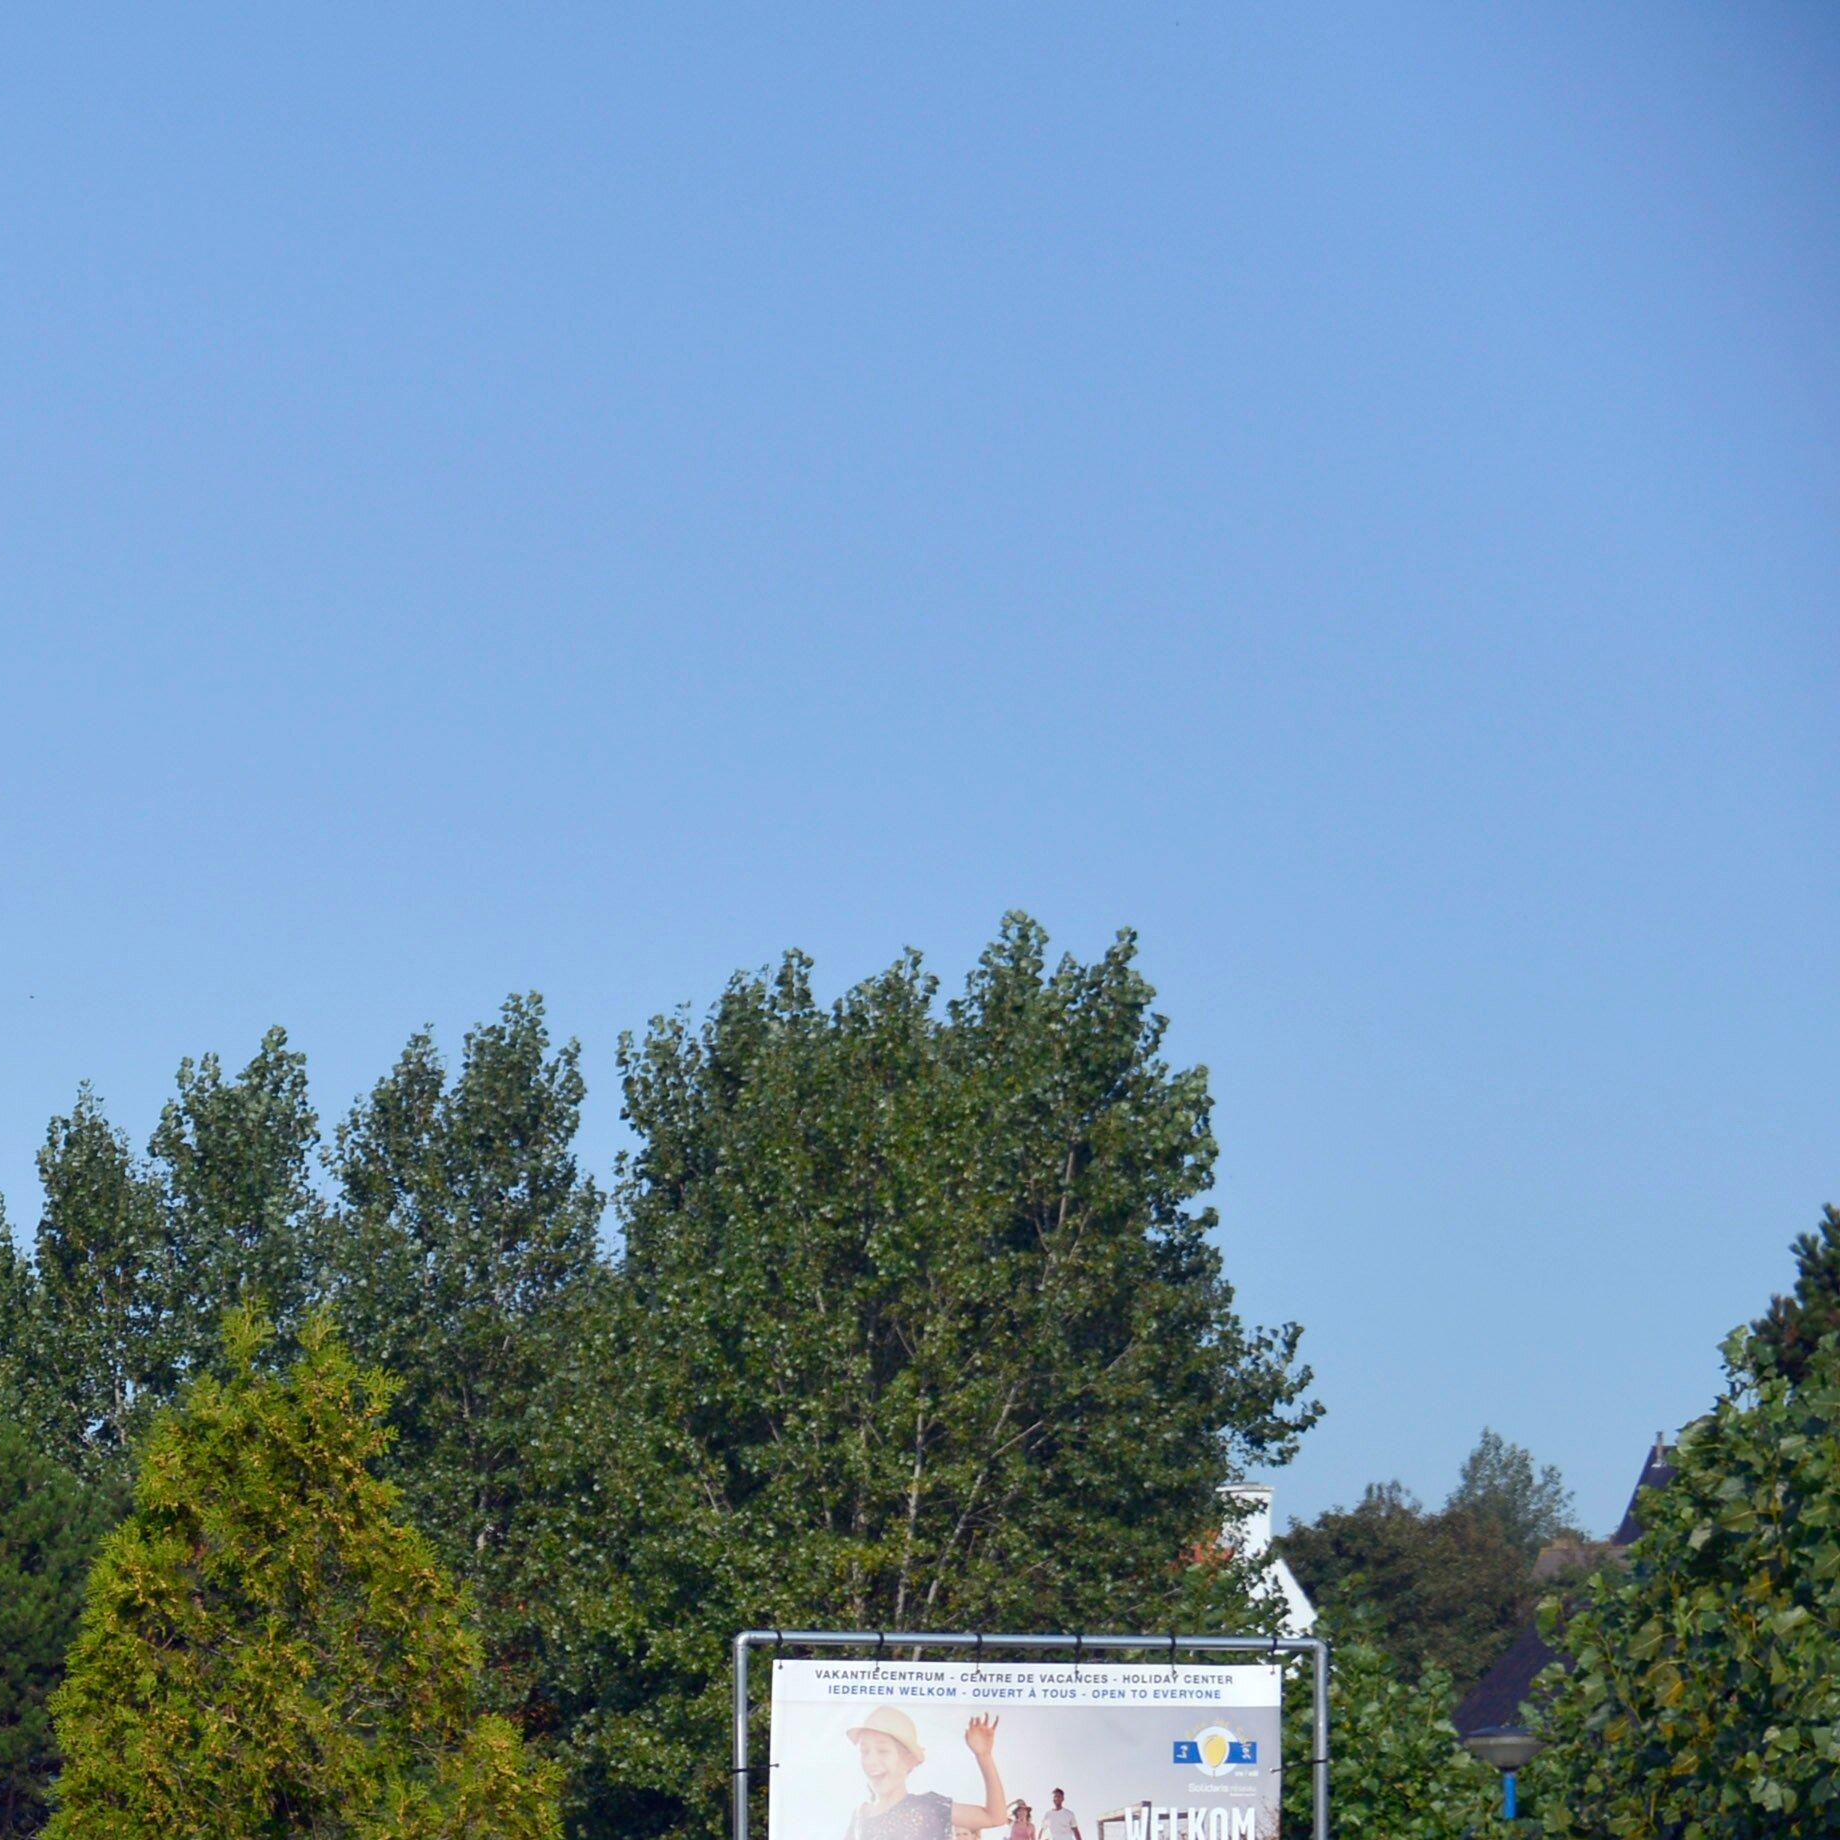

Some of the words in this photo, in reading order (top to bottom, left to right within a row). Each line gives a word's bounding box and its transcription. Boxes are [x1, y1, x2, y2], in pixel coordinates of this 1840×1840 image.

[815, 1669, 945, 1682] VAKANTIECENTRUM
[960, 1672, 1012, 1683] CENTRE
[1017, 1673, 1034, 1683] DE
[1039, 1673, 1109, 1684] VACANCES
[1122, 1674, 1178, 1684] HOLIDAY
[1183, 1674, 1233, 1685] CENTER
[828, 1685, 894, 1696] IEDEREEN
[899, 1686, 957, 1697] WELKOM
[972, 1688, 1022, 1698] OUVERT
[1042, 1689, 1077, 1699] TOUS
[1091, 1689, 1126, 1699] OPEN
[1132, 1689, 1148, 1699] TO
[1153, 1689, 1221, 1699] EVERYONE
